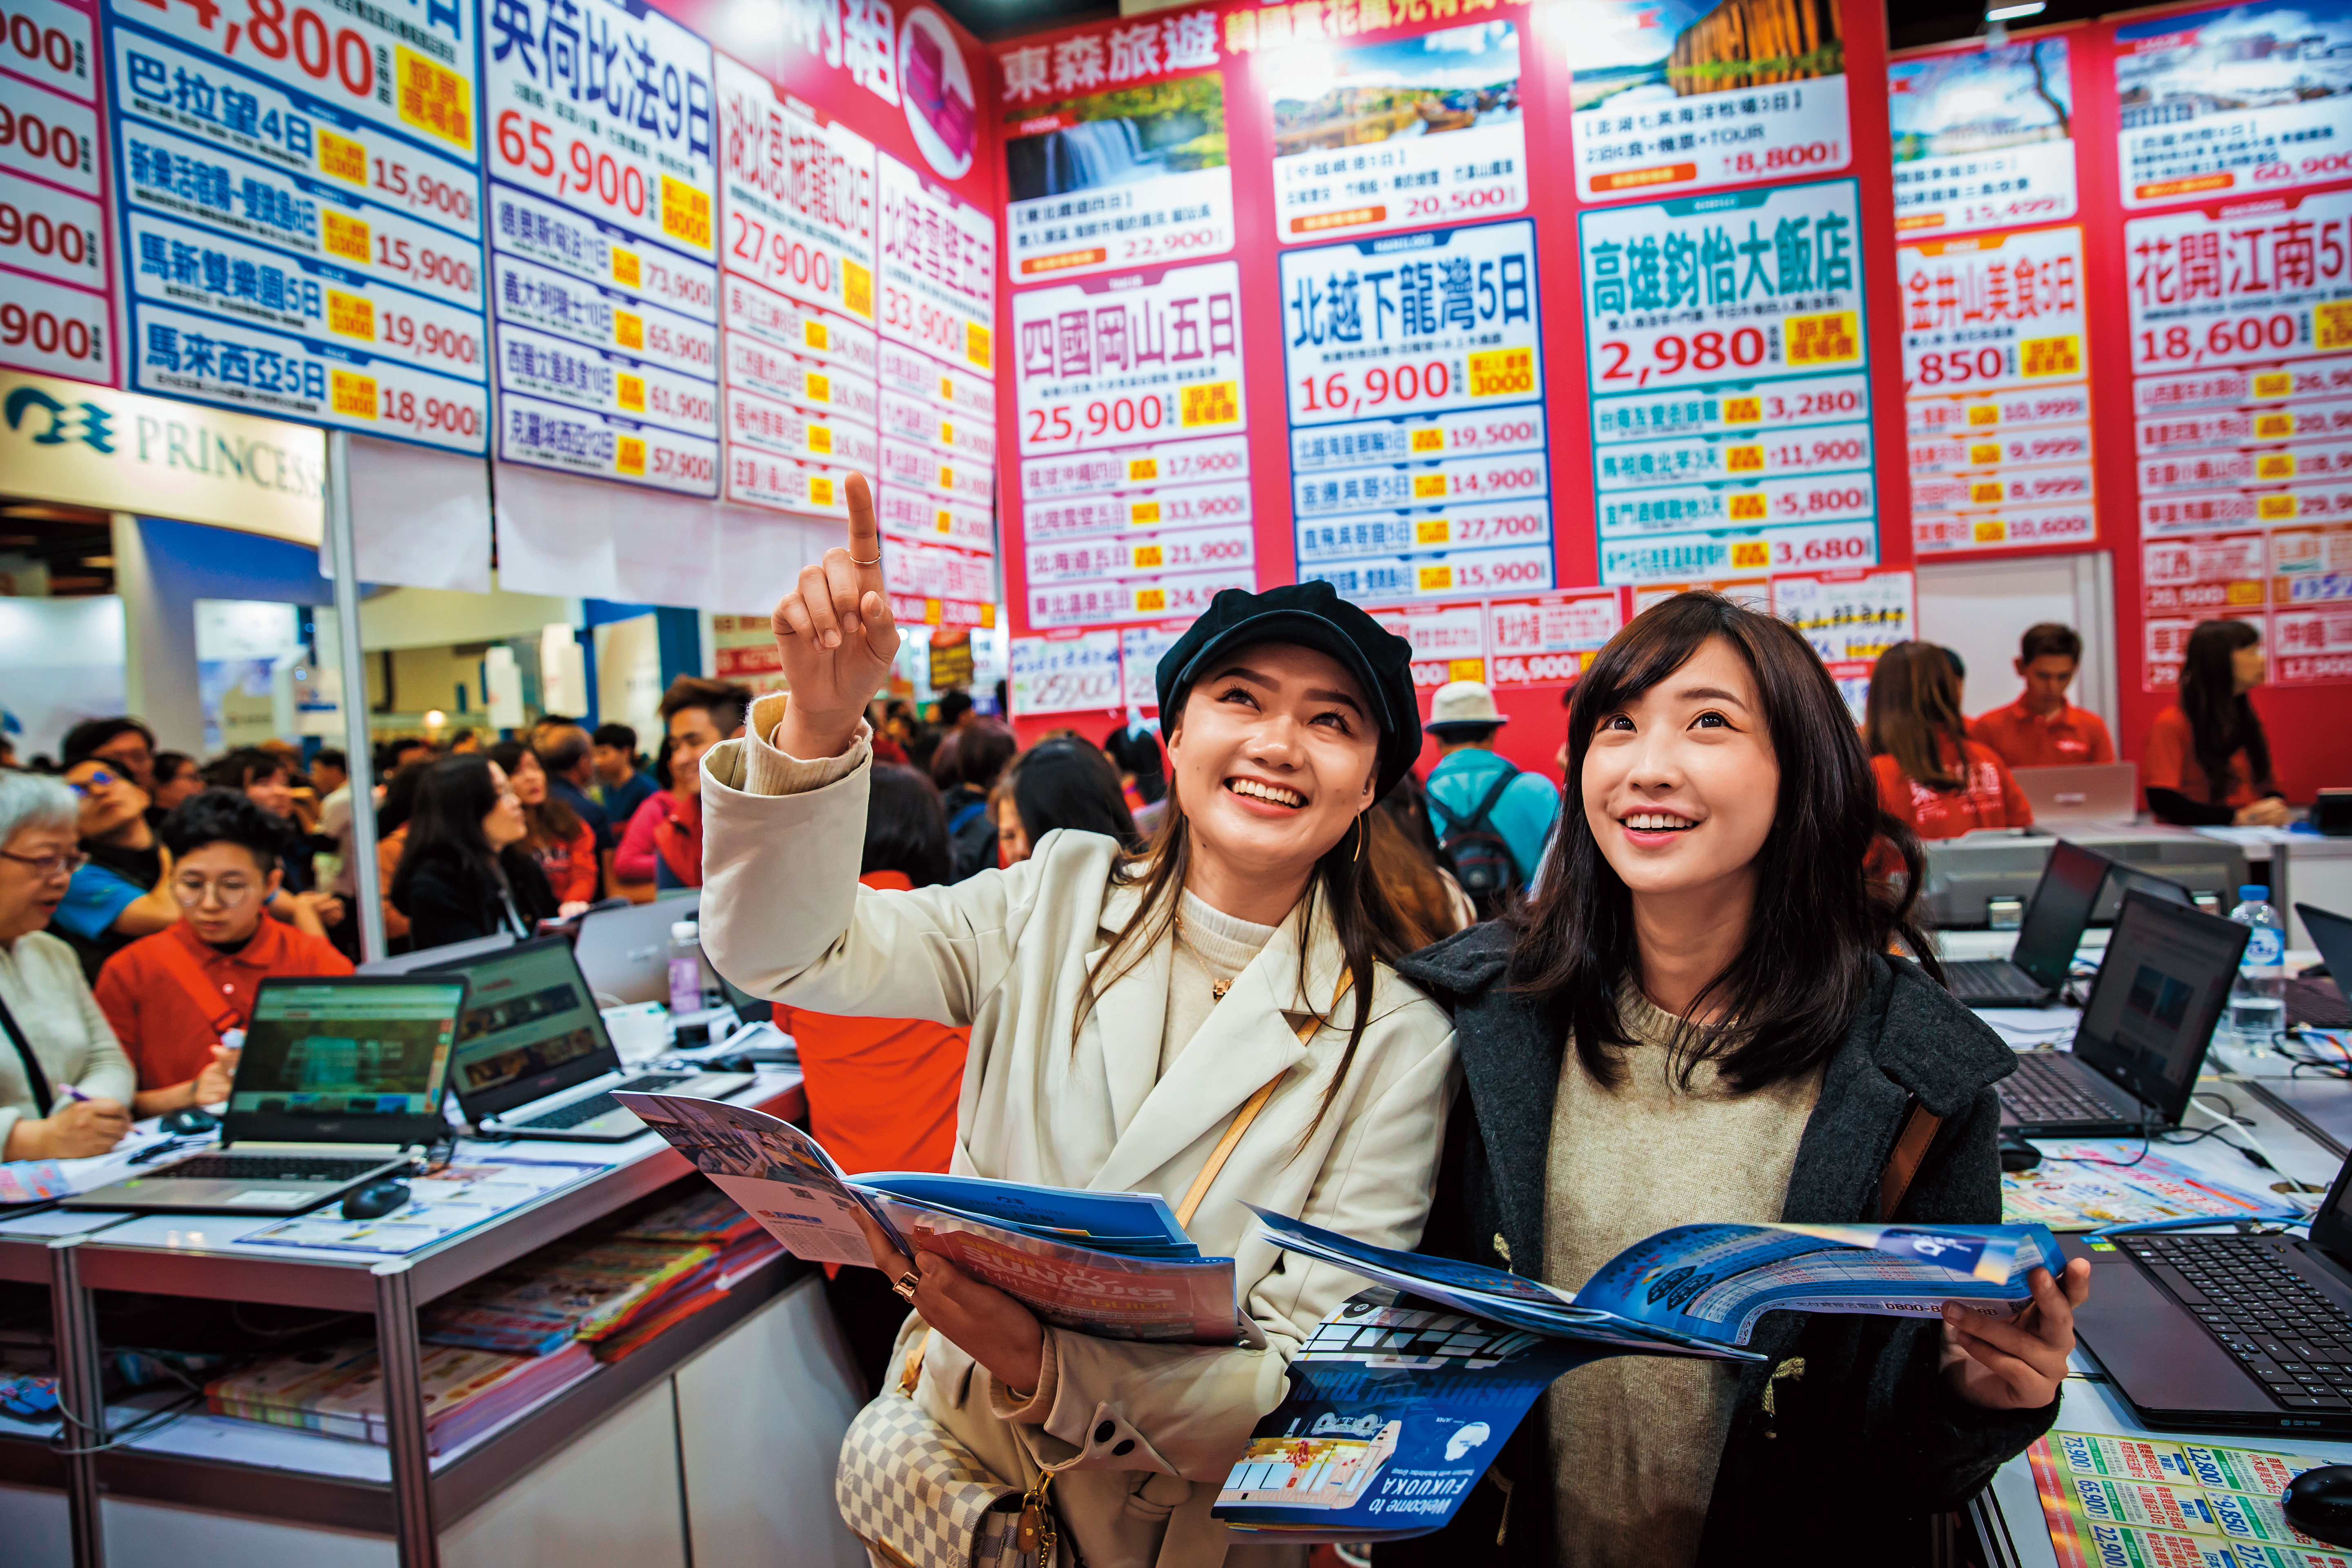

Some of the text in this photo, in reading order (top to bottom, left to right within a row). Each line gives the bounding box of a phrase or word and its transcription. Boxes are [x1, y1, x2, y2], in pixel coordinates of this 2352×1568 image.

[0, 8, 73, 73] 00
[1000, 17, 1220, 101] 東森旅遊
[126, 49, 312, 158] 巴拉望4日
[374, 157, 470, 220] 15,900
[498, 110, 644, 217] 65,900
[1408, 186, 1506, 219] 20,500
[377, 234, 472, 292] 15,900
[732, 212, 829, 292] 27,900
[1590, 211, 1853, 316] 高雄鈞怡大飯店
[2134, 215, 2352, 306] 花開江南5
[1291, 254, 1529, 348] 北越下龍灣5日
[1, 303, 89, 359] 900
[383, 312, 476, 363] 19,900
[1022, 293, 1235, 381] 四國岡山五日
[2140, 313, 2294, 367] 18,600
[146, 323, 325, 401] 馬來西亞5日
[1601, 327, 1764, 388] 2,980
[1301, 361, 1448, 414] 16,900
[1476, 373, 1531, 394] 1000
[1768, 390, 1856, 421] 3,280
[382, 388, 477, 436] 18,900
[1028, 395, 1161, 450] 25,900
[1452, 422, 1532, 448] 19,500
[136, 414, 325, 499] PRINCES
[1169, 452, 1239, 477] 17,900
[1459, 561, 1539, 587] 15,900
[1776, 537, 1864, 568] 3,680
[1494, 656, 1573, 683] 56,900
[969, 1199, 1066, 1218] PRINCESS CRUISES
[2063, 1436, 2091, 1470] 73,900
[2187, 1447, 2223, 1483] 12,800
[2247, 1453, 2283, 1494] 小木屋美食5日
[1368, 1497, 1452, 1515] Welcome to
[1381, 1477, 1469, 1496] FUKUOKA
[2078, 1480, 2109, 1516] 65,900
[2213, 1500, 2249, 1533] 9,850
[2093, 1525, 2129, 1568] 22,900
